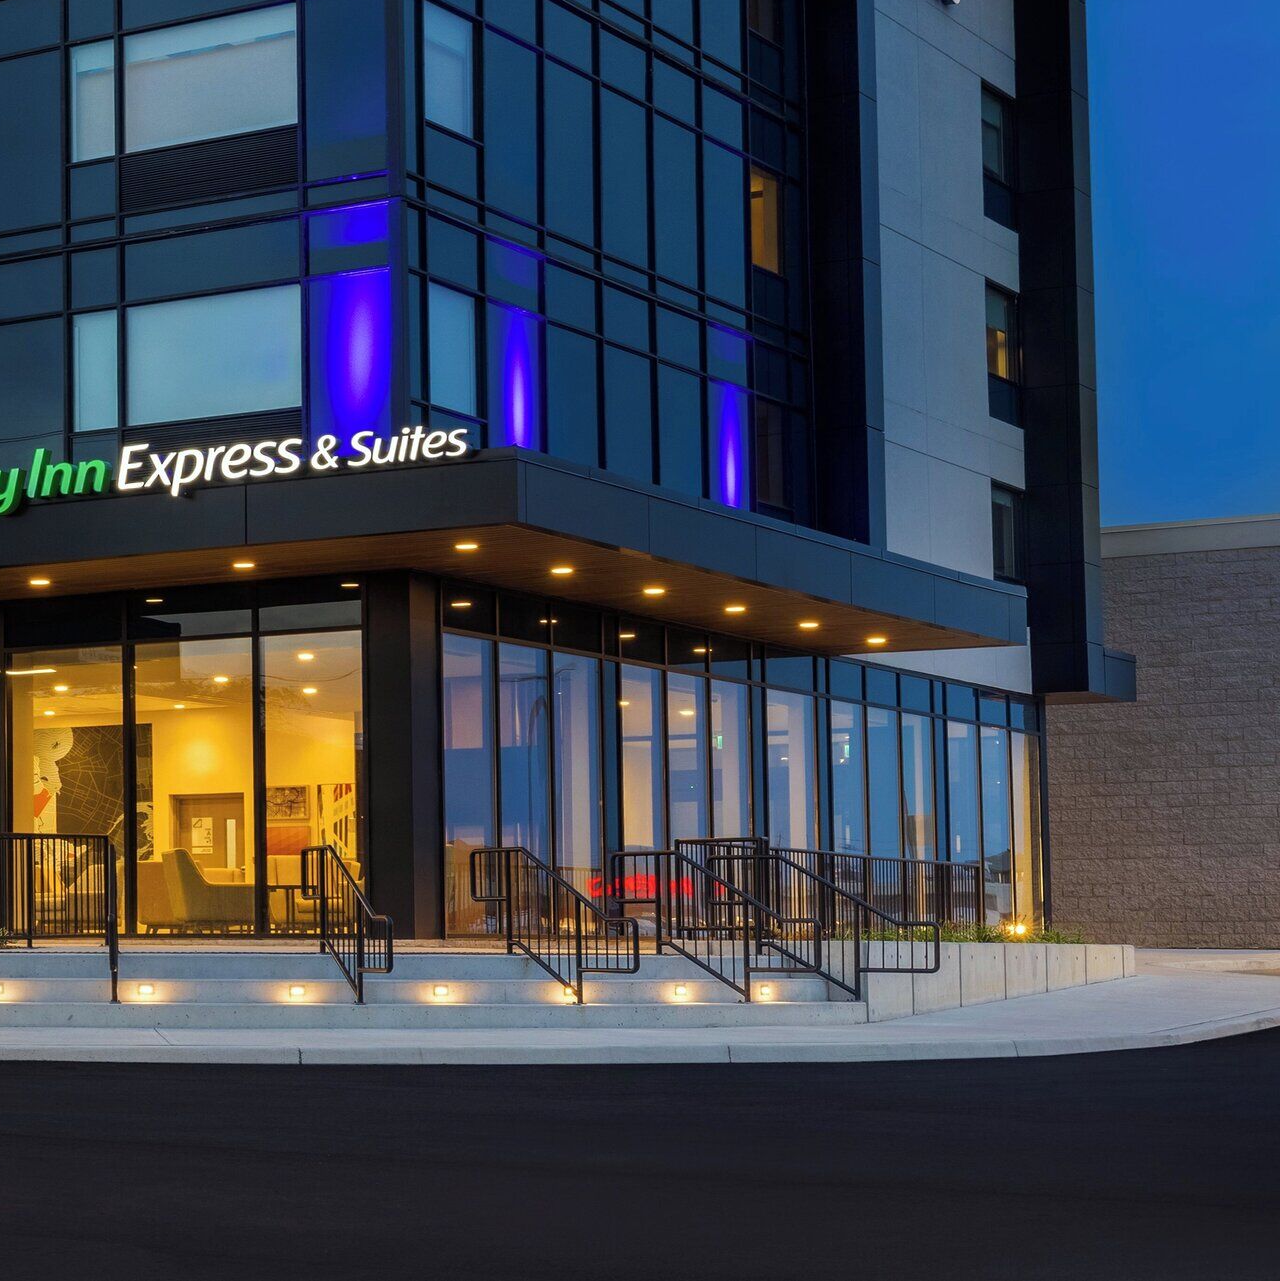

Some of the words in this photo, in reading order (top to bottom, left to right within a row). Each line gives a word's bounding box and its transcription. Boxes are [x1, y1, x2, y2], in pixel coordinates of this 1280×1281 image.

[27, 448, 108, 499] Inn
[117, 443, 303, 497] Express
[310, 434, 340, 470] &
[347, 425, 469, 468] Suites
